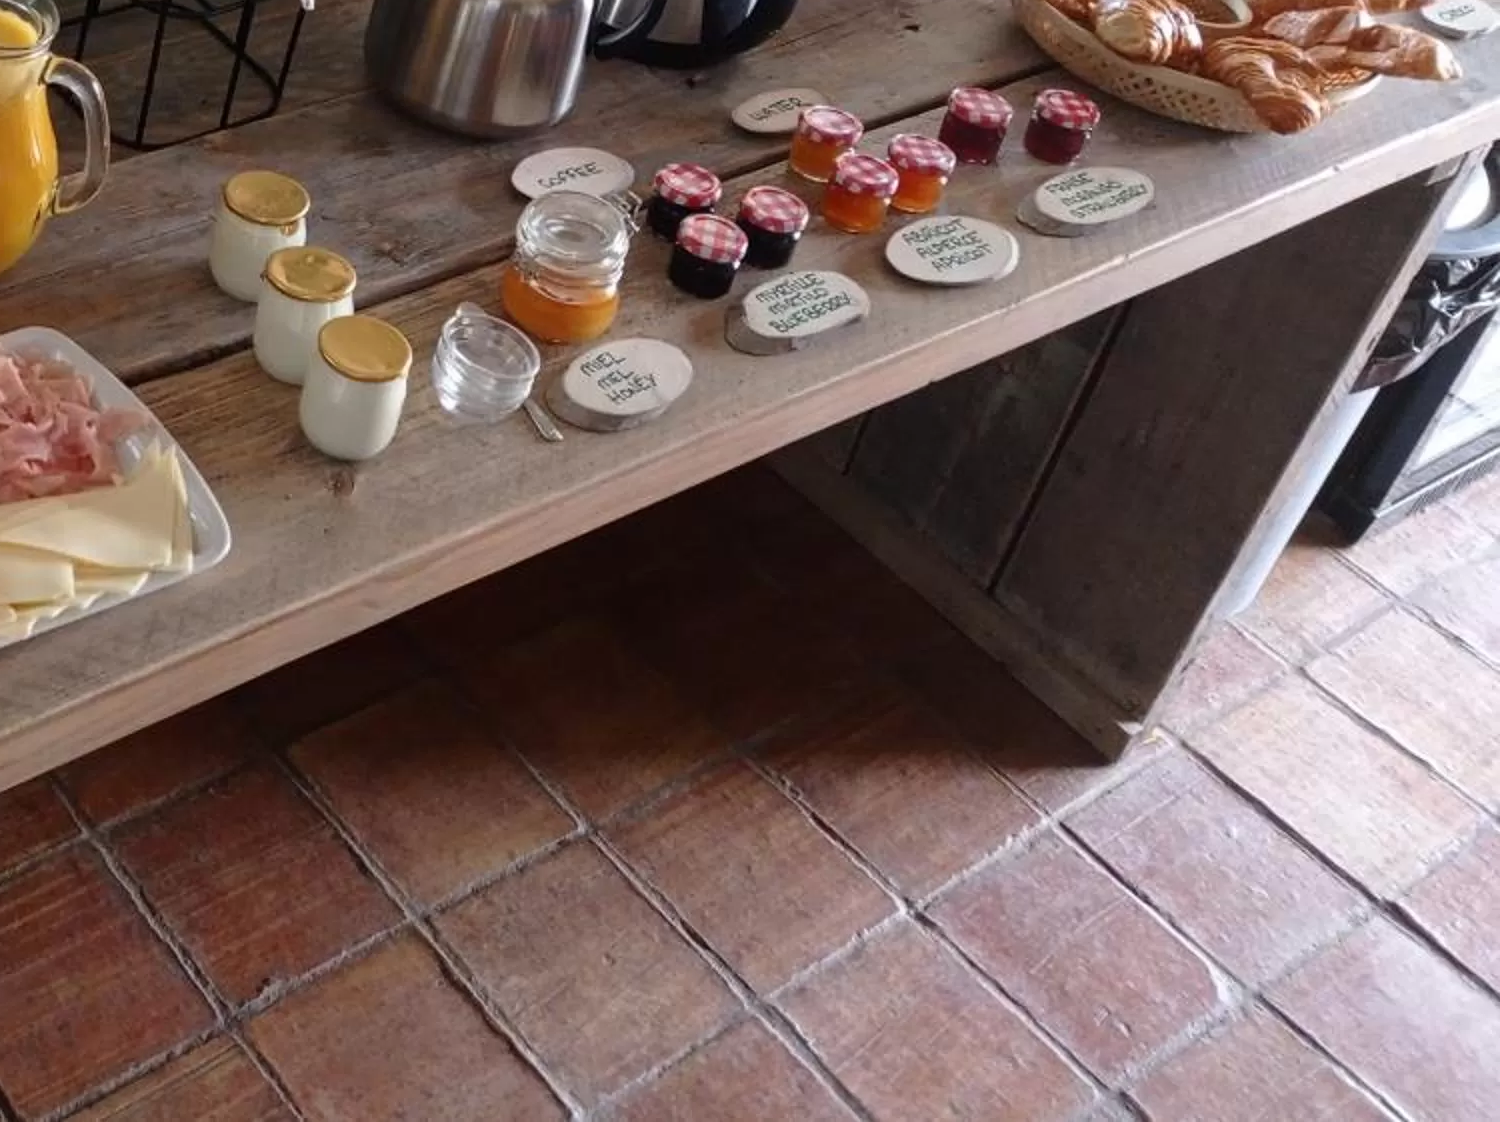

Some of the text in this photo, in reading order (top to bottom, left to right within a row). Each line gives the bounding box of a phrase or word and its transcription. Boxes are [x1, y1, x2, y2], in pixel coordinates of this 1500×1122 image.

[747, 96, 803, 120] WATER
[536, 161, 604, 188] COFFEE
[580, 351, 627, 377] MIEL
[597, 369, 635, 390] MEL
[604, 373, 657, 405] HONEY
